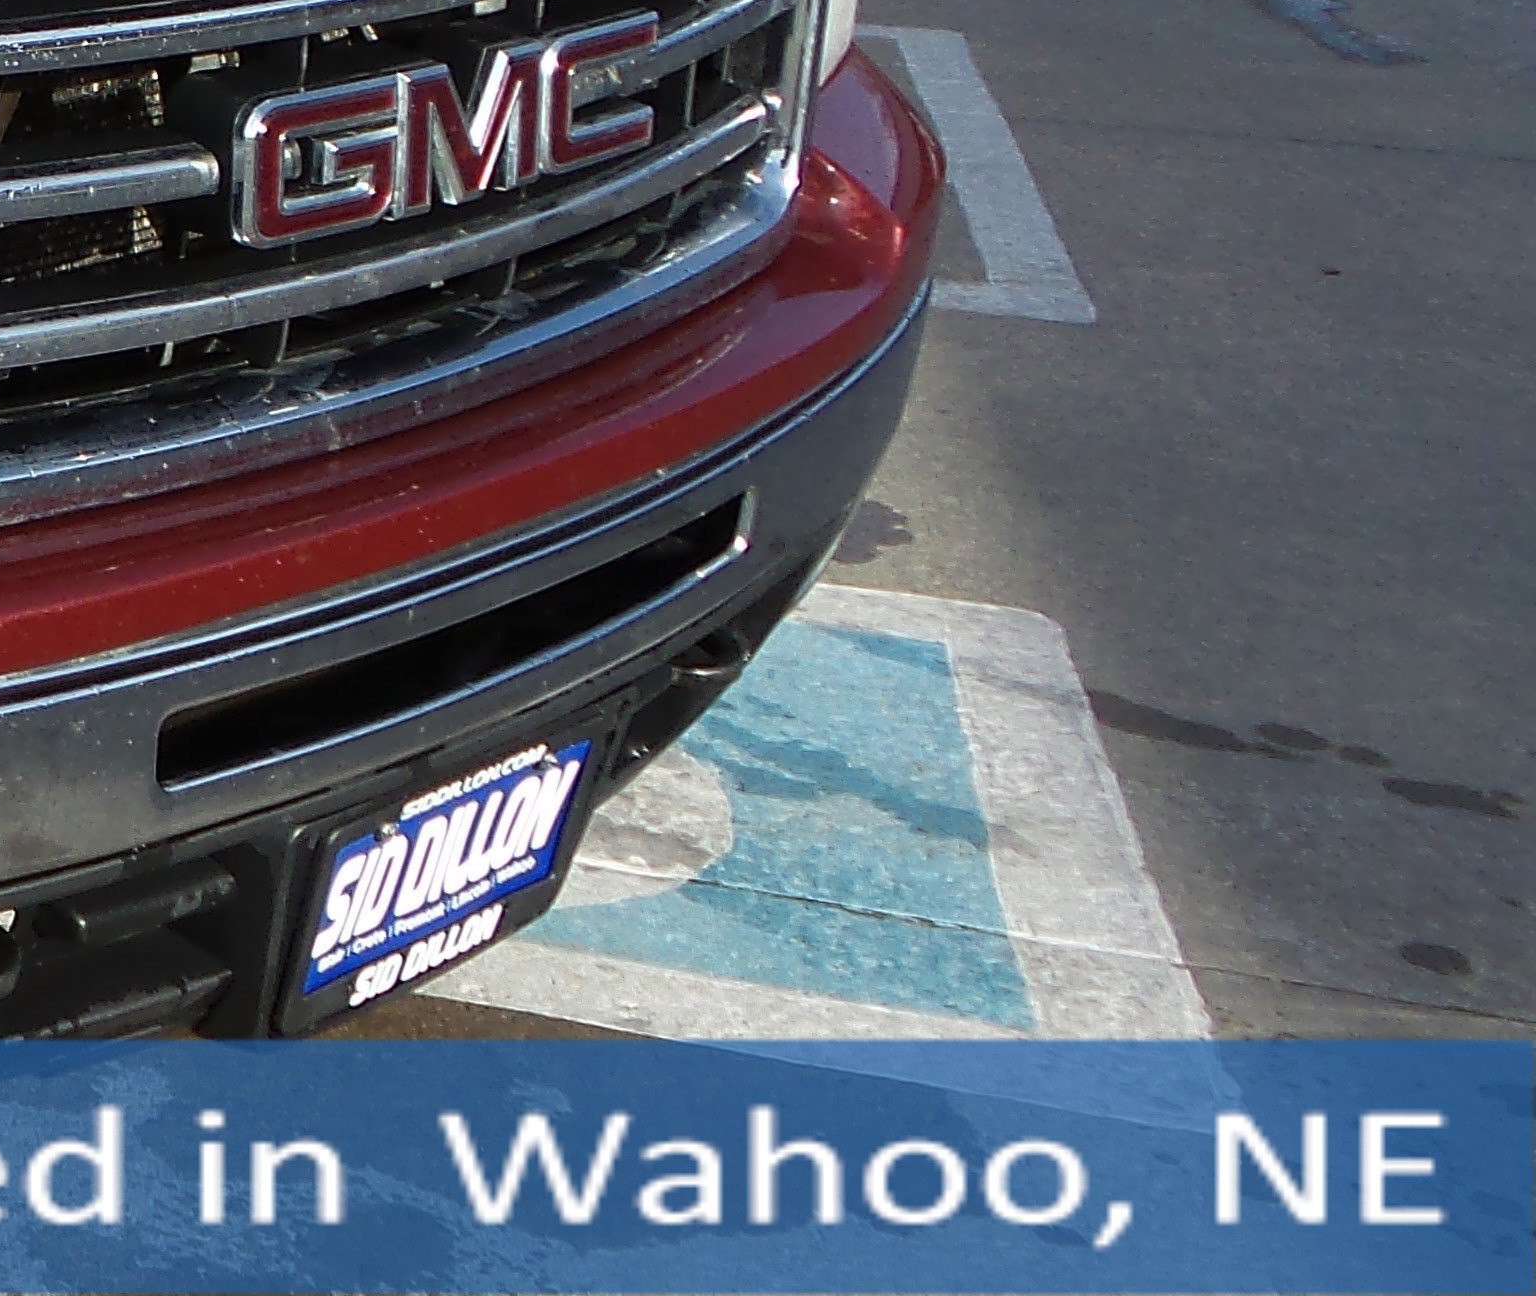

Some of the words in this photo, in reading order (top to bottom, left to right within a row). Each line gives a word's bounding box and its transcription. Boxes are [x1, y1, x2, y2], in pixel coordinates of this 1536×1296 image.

[232, 9, 660, 250] GMC
[311, 834, 408, 960] SID
[394, 760, 580, 918] DILLON
[350, 953, 403, 1007] SID
[400, 903, 504, 982] DILLON
